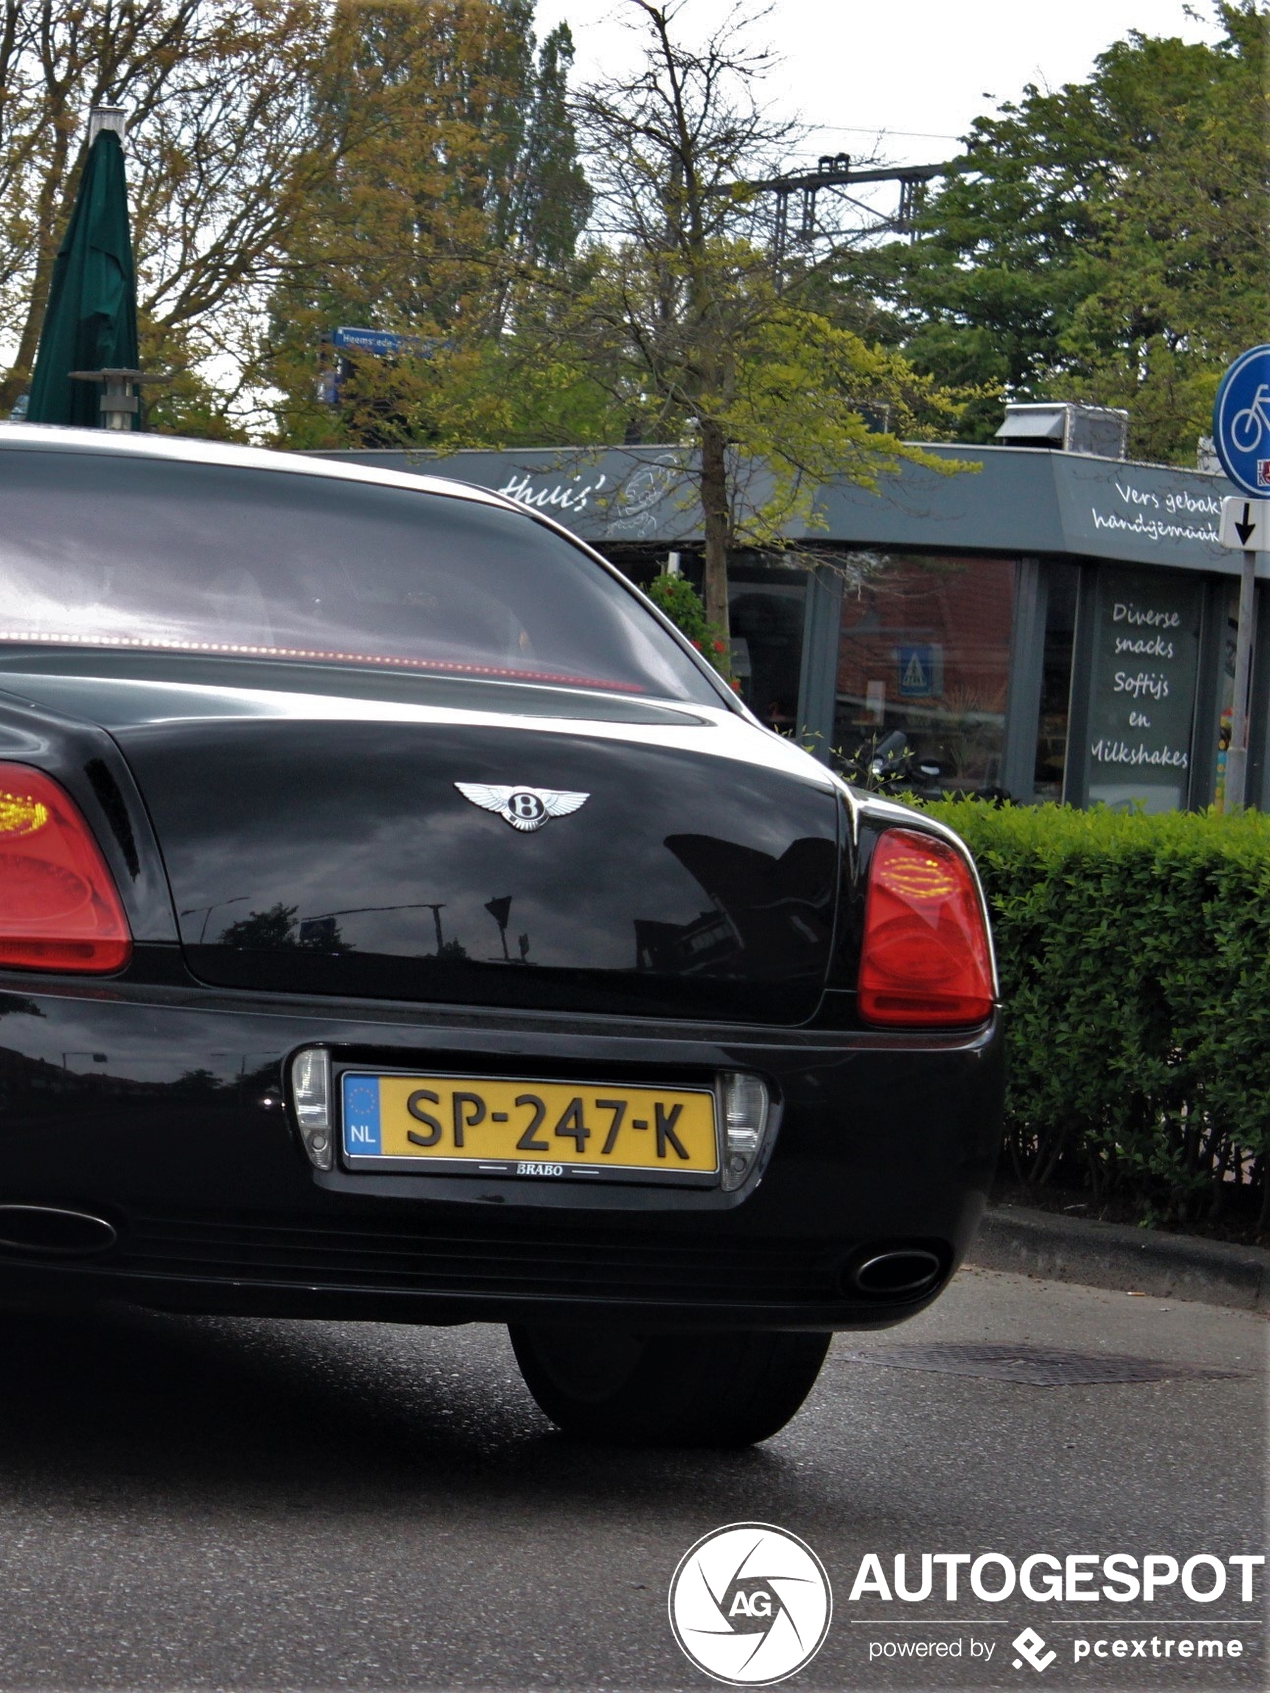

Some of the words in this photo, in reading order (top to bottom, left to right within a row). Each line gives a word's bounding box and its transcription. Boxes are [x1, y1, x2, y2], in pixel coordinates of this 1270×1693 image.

[1115, 482, 1160, 509] Vers
[1112, 603, 1181, 628] Diverse
[1114, 635, 1174, 659] snacks
[1113, 671, 1169, 700] Softijs
[1129, 710, 1151, 728] en
[1090, 739, 1189, 769] Milkshakes
[350, 1125, 376, 1143] NL
[406, 1089, 691, 1160] SP-247-K
[516, 1162, 564, 1177] BRABO
